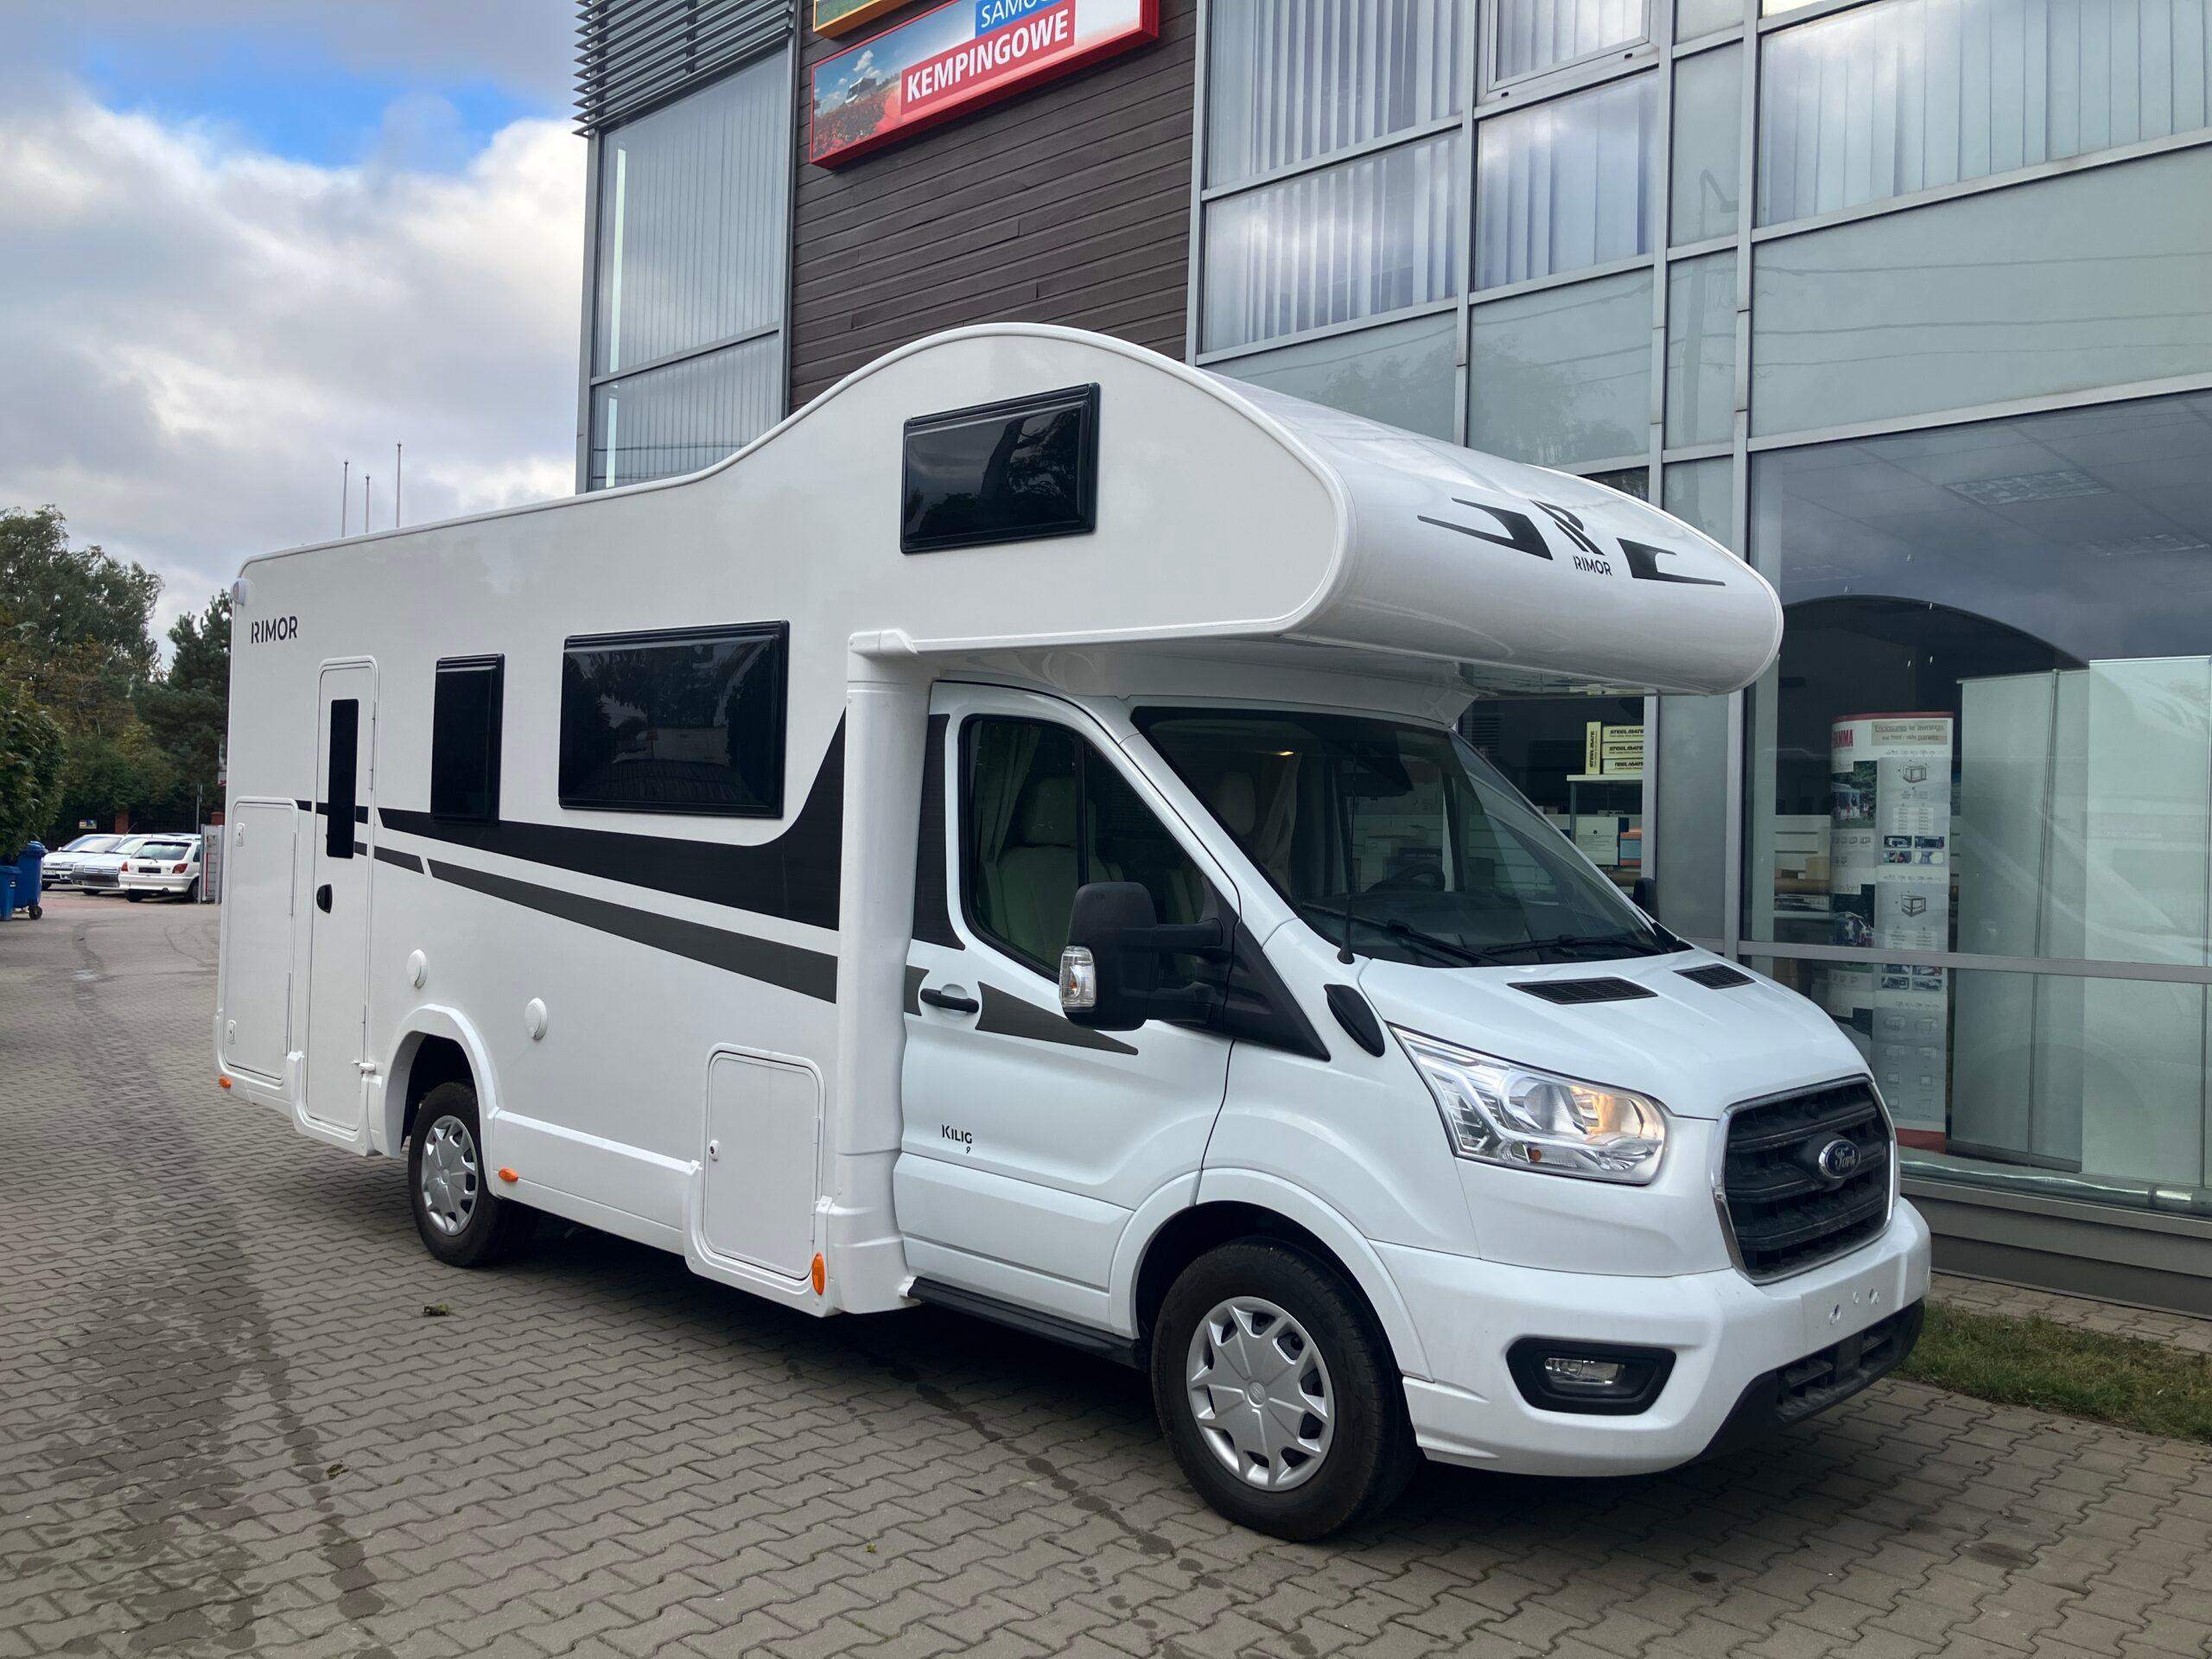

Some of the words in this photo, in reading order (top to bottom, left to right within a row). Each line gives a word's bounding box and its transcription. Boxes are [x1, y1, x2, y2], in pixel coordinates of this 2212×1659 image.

[981, 0, 1048, 29] SAM
[907, 9, 1069, 103] KEMPINGOWE
[1573, 556, 1613, 576] RIMOR
[251, 615, 298, 645] RIMOR
